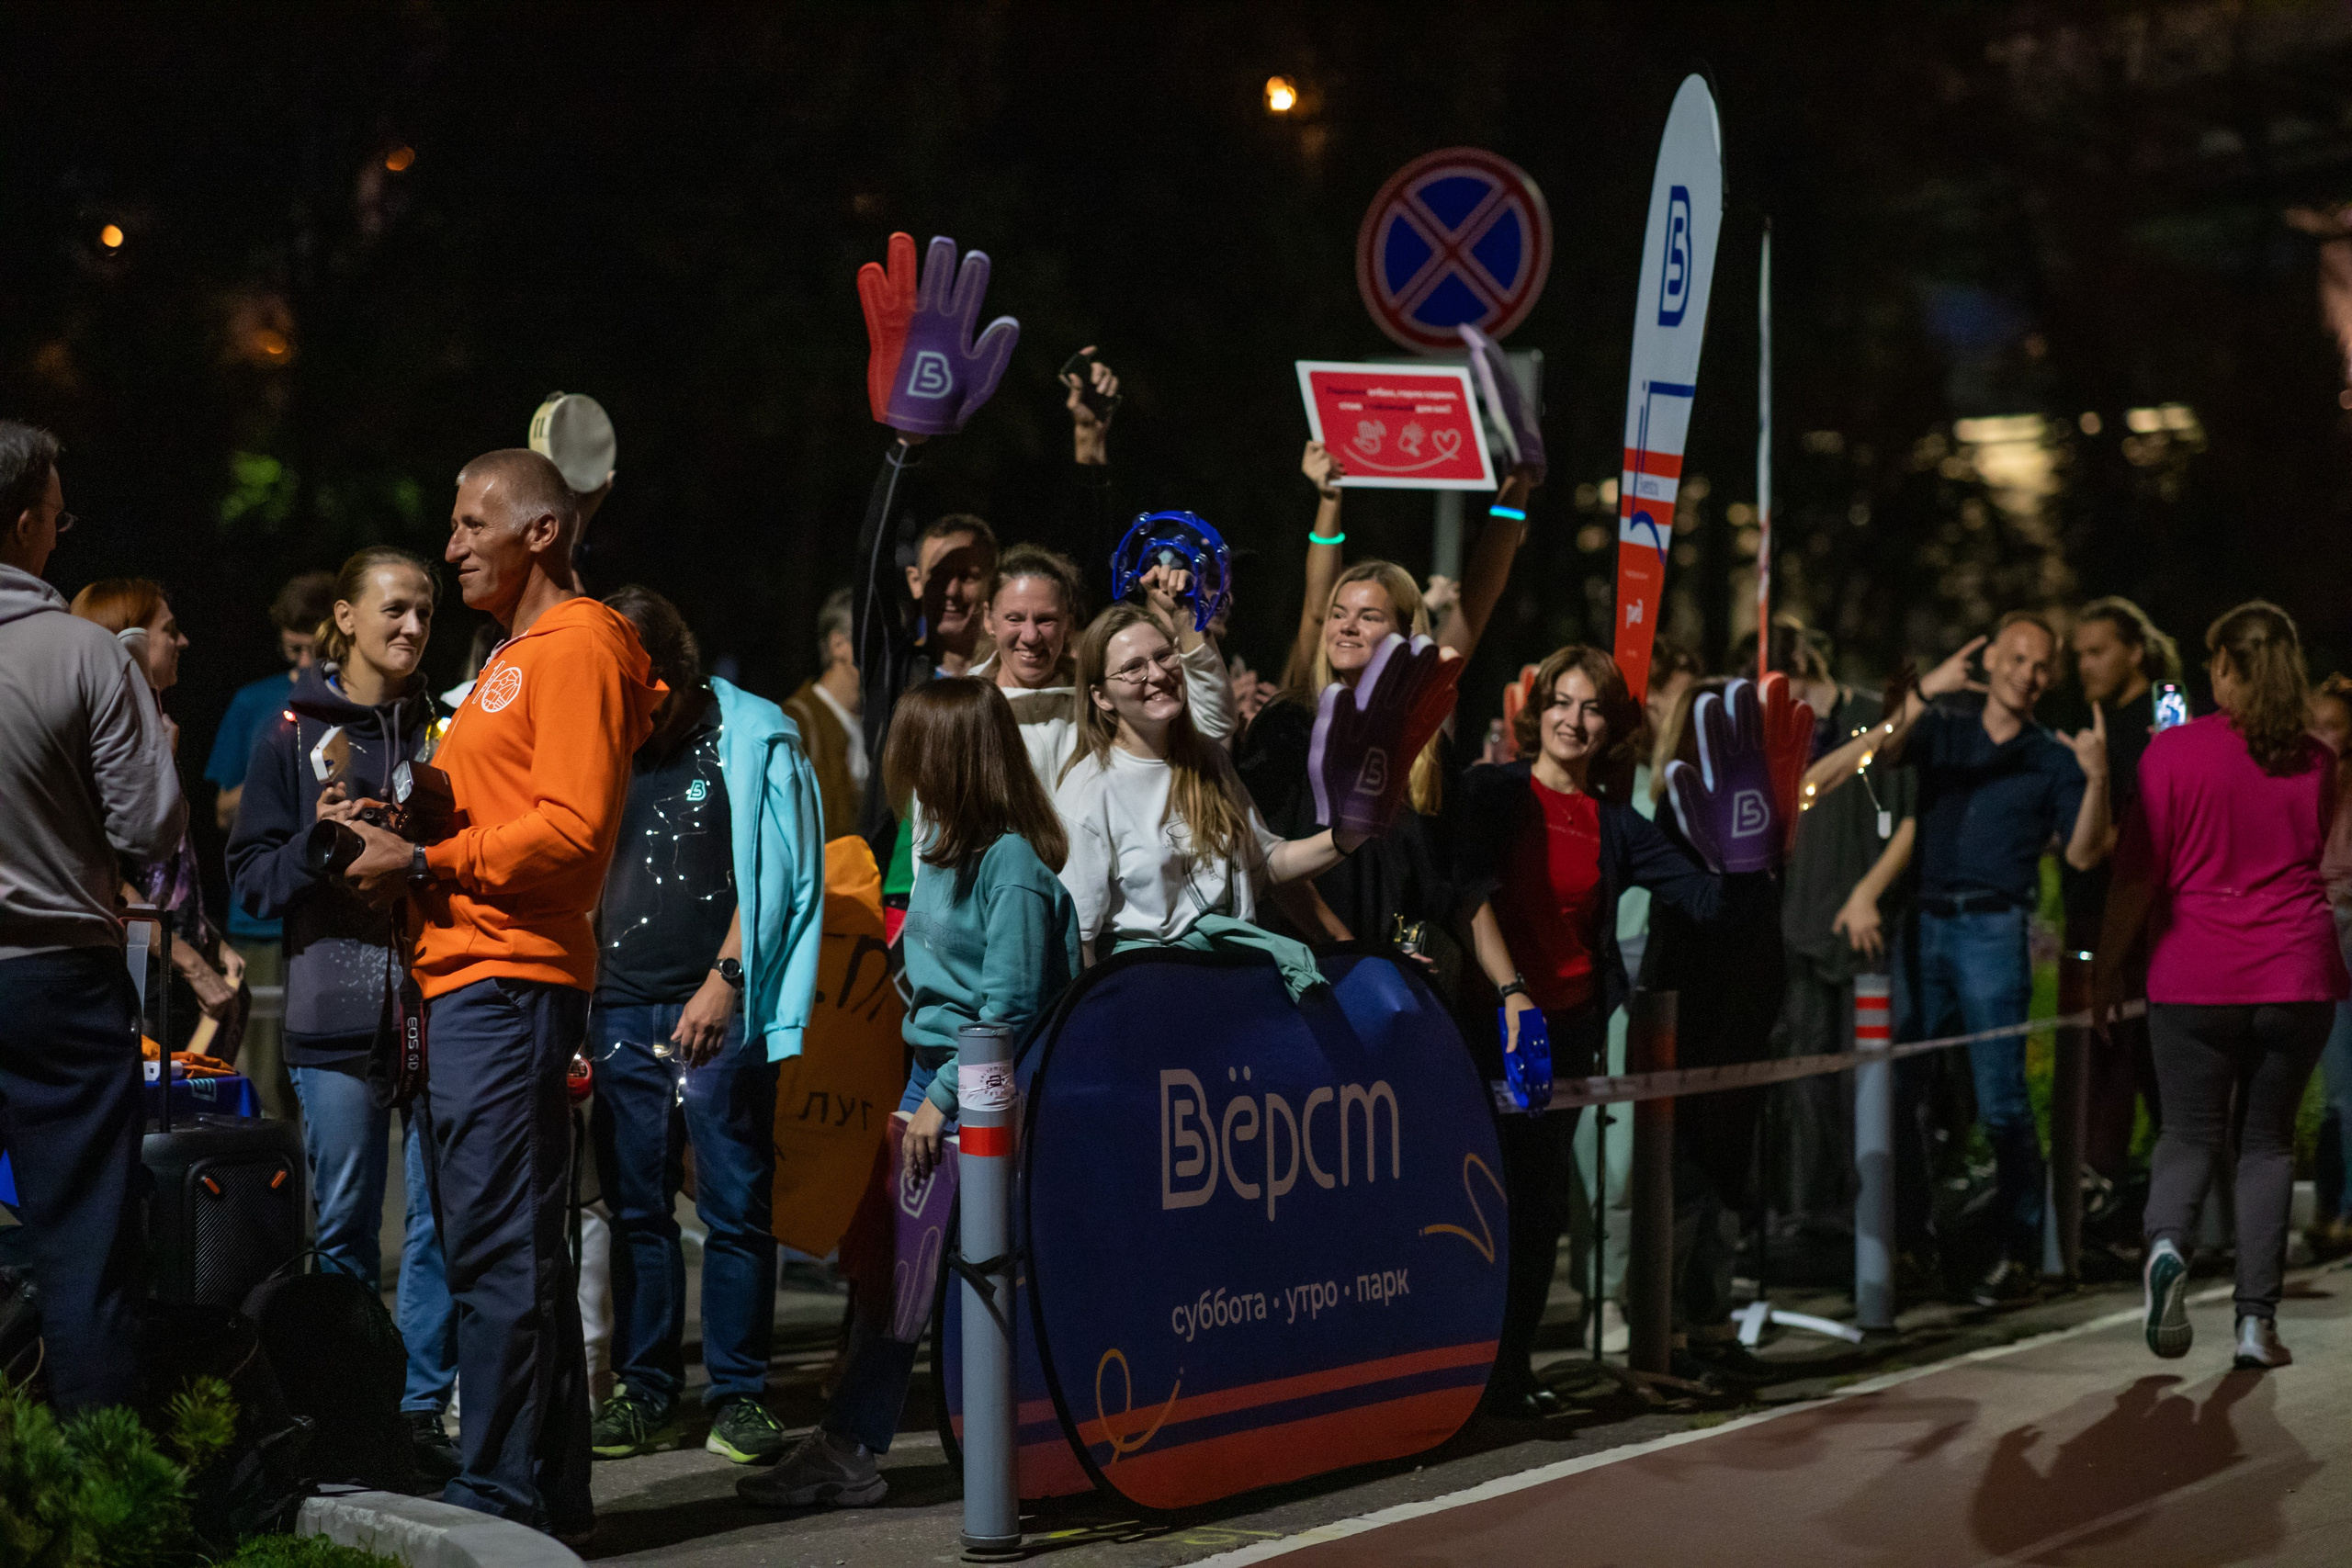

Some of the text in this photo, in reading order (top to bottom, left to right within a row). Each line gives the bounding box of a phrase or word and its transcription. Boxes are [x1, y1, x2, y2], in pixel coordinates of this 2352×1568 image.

[407, 1016, 419, 1050] EOS
[407, 1054, 419, 1071] 6D
[1172, 1268, 1410, 1342] суббота утро парк
